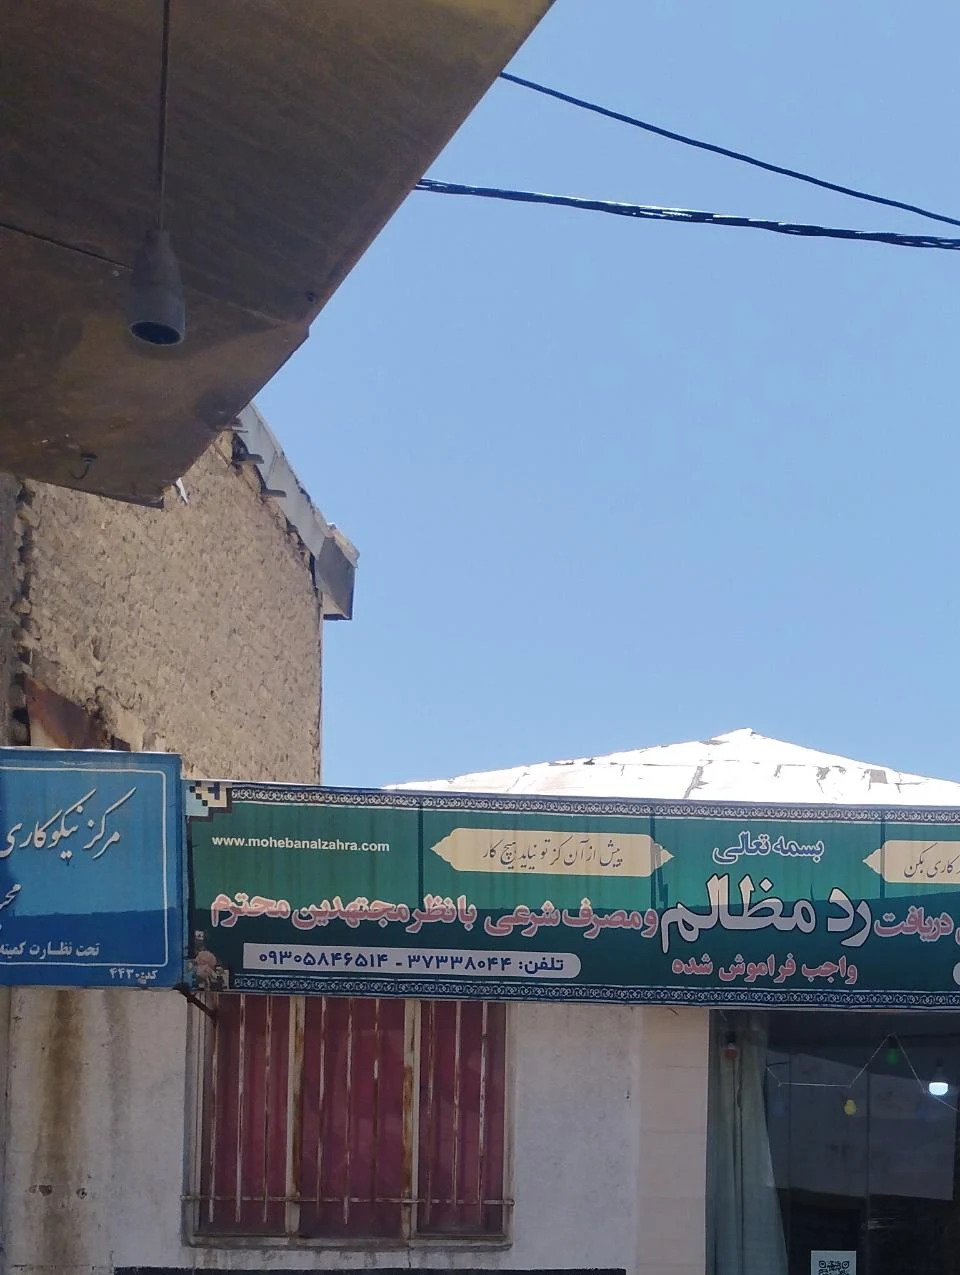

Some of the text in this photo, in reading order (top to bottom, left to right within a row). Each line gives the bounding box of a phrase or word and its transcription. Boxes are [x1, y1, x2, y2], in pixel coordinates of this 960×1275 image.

[0, 786, 137, 861] مرکز نیکوکاری
[211, 836, 391, 853] www.mohebanalzahra.com
[482, 838, 504, 859] کار
[500, 840, 518, 870] هیچ
[519, 843, 538, 871] نیاید
[539, 838, 551, 861] تو
[549, 835, 572, 866] کز
[599, 839, 623, 868] پیش
[713, 830, 825, 865] بسمه تعالی
[903, 842, 939, 878] بکن
[926, 856, 960, 879] کاری
[211, 892, 291, 928] محترم
[291, 895, 411, 931] مجتهدین
[483, 899, 561, 938] شرعی
[660, 873, 873, 954] رد مظالم
[873, 905, 955, 943] دریافت
[29, 931, 73, 961] نظارت
[75, 933, 101, 957] تحت
[671, 952, 858, 985] واجب فراموش شده
